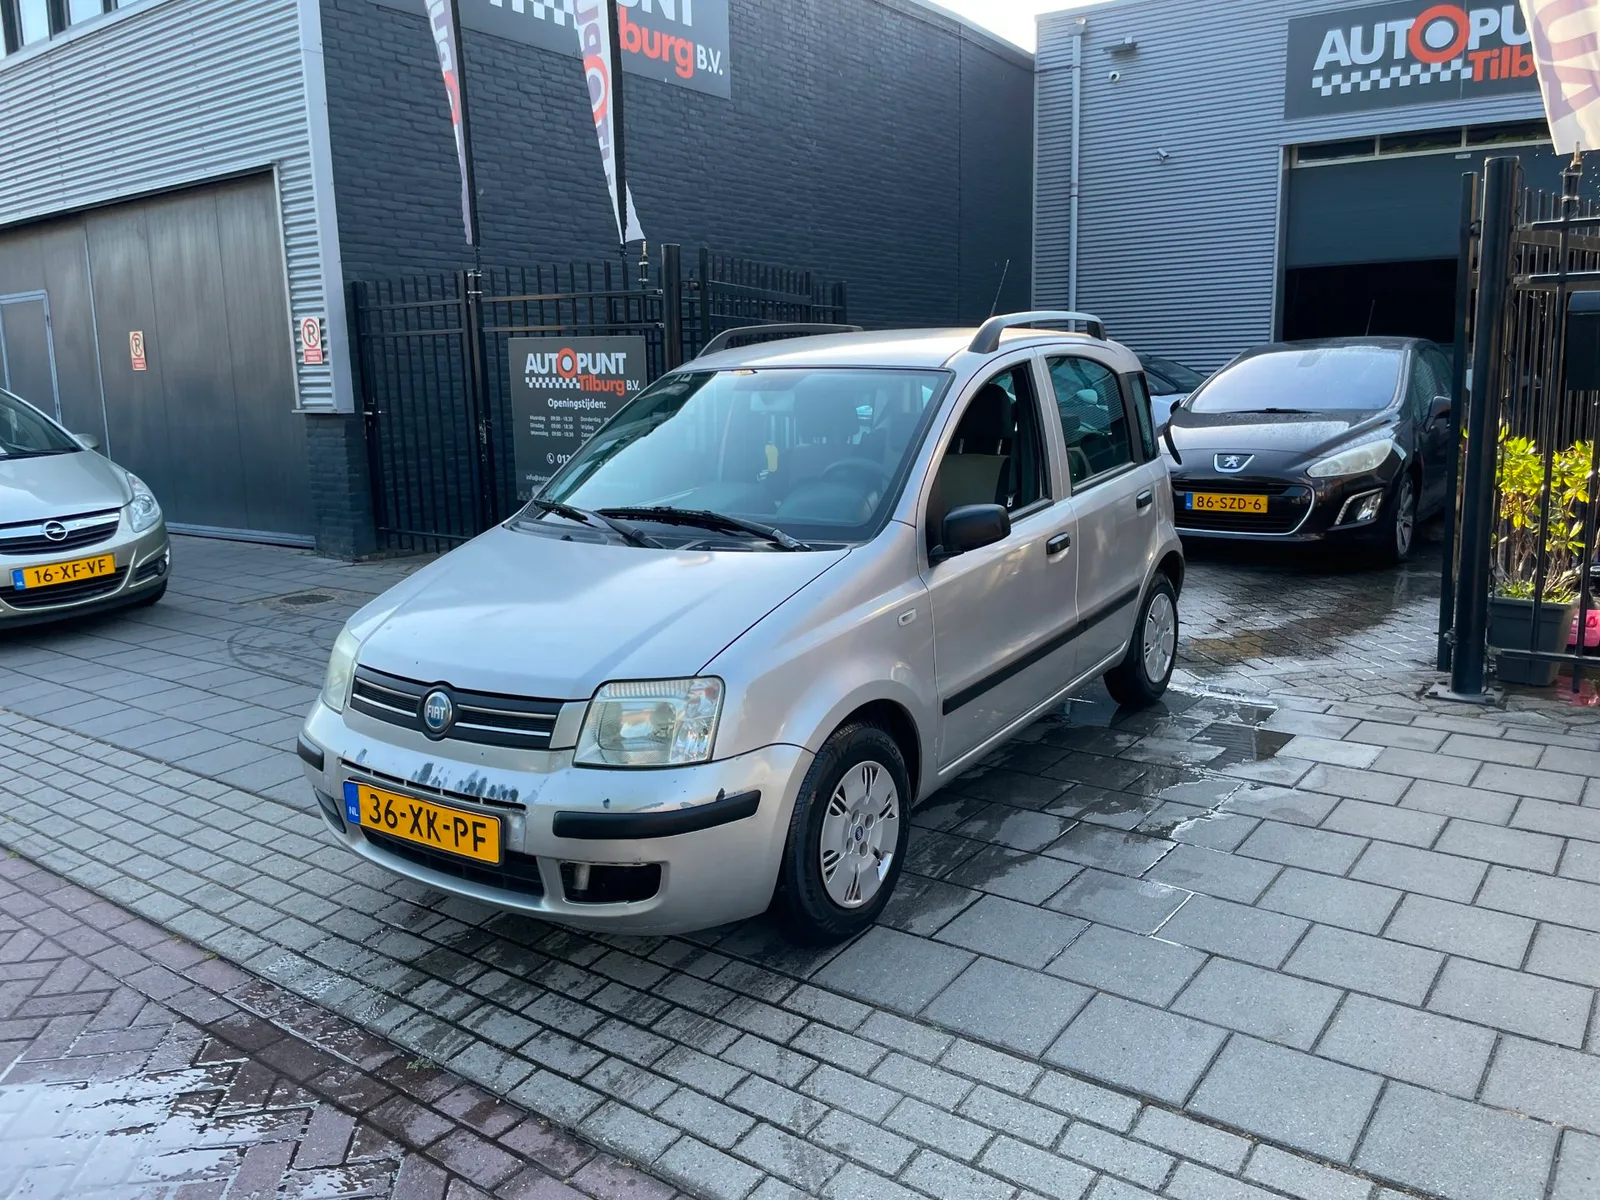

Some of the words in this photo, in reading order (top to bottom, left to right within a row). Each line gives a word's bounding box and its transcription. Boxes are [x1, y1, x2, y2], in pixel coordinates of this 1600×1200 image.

[619, 6, 694, 79] burg
[697, 44, 724, 76] B.V.
[1313, 4, 1531, 71] AUTOPU
[1468, 45, 1537, 82] Tilb
[525, 347, 627, 379] AUTOPUNT
[578, 374, 625, 396] Tilburg
[626, 380, 640, 391] B.V.
[547, 397, 607, 410] Openingstijden:
[1197, 496, 1261, 510] 86-SZD-6
[34, 559, 106, 583] 16-XF-VF
[426, 705, 446, 720] FIAT
[348, 805, 359, 817] NL
[368, 792, 487, 853] 36-XK-PF
